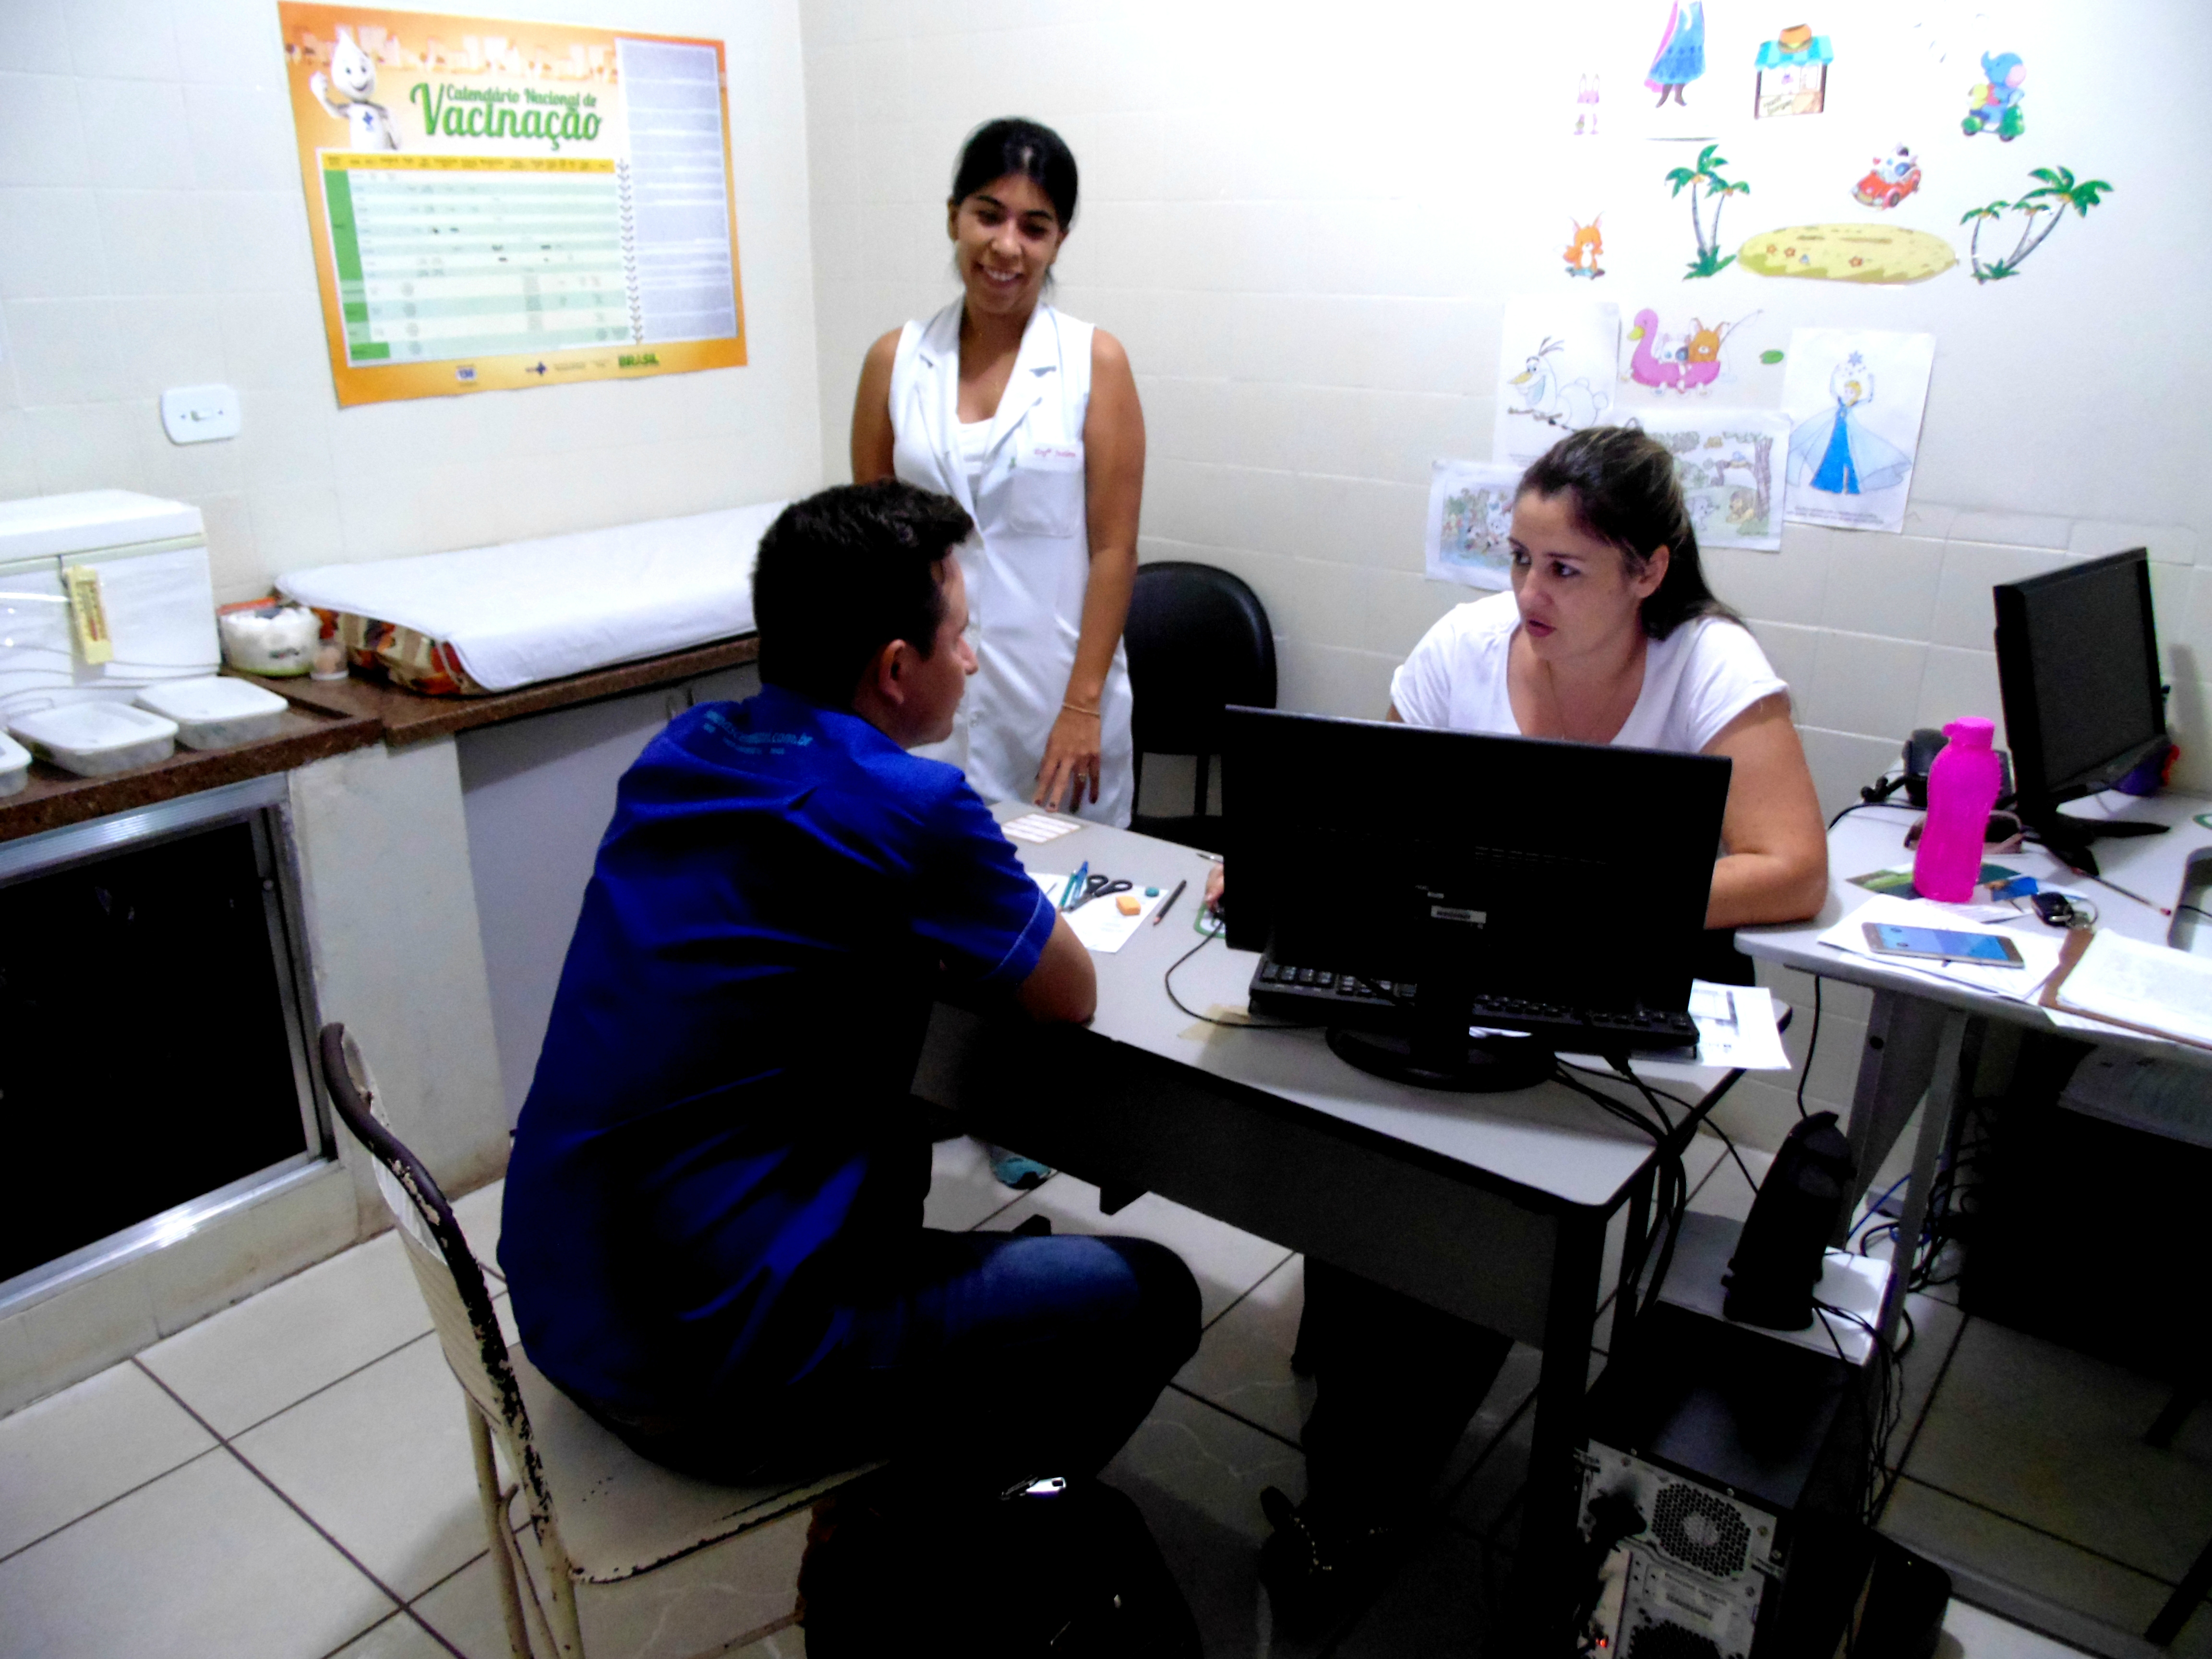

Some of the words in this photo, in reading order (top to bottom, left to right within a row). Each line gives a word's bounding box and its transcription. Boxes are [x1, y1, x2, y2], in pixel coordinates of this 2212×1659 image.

[409, 83, 601, 151] Vacinação
[447, 83, 520, 103] Calendário
[524, 86, 580, 108] Nacional
[583, 92, 597, 107] de
